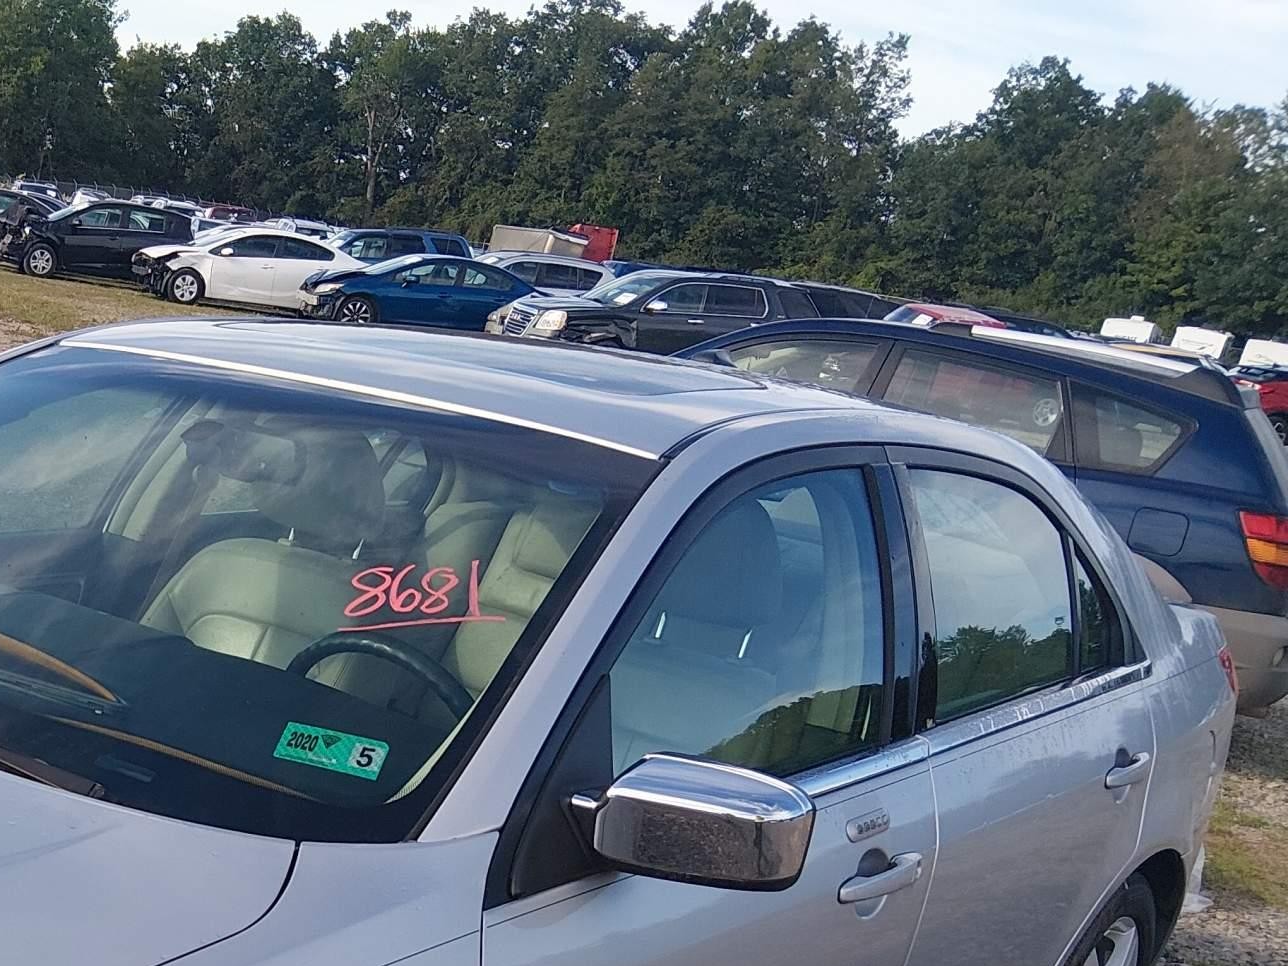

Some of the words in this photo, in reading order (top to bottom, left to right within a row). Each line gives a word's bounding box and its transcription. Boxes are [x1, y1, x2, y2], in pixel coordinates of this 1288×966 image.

[343, 559, 480, 617] 8681
[285, 731, 320, 753] 2020
[355, 745, 377, 768] 5
